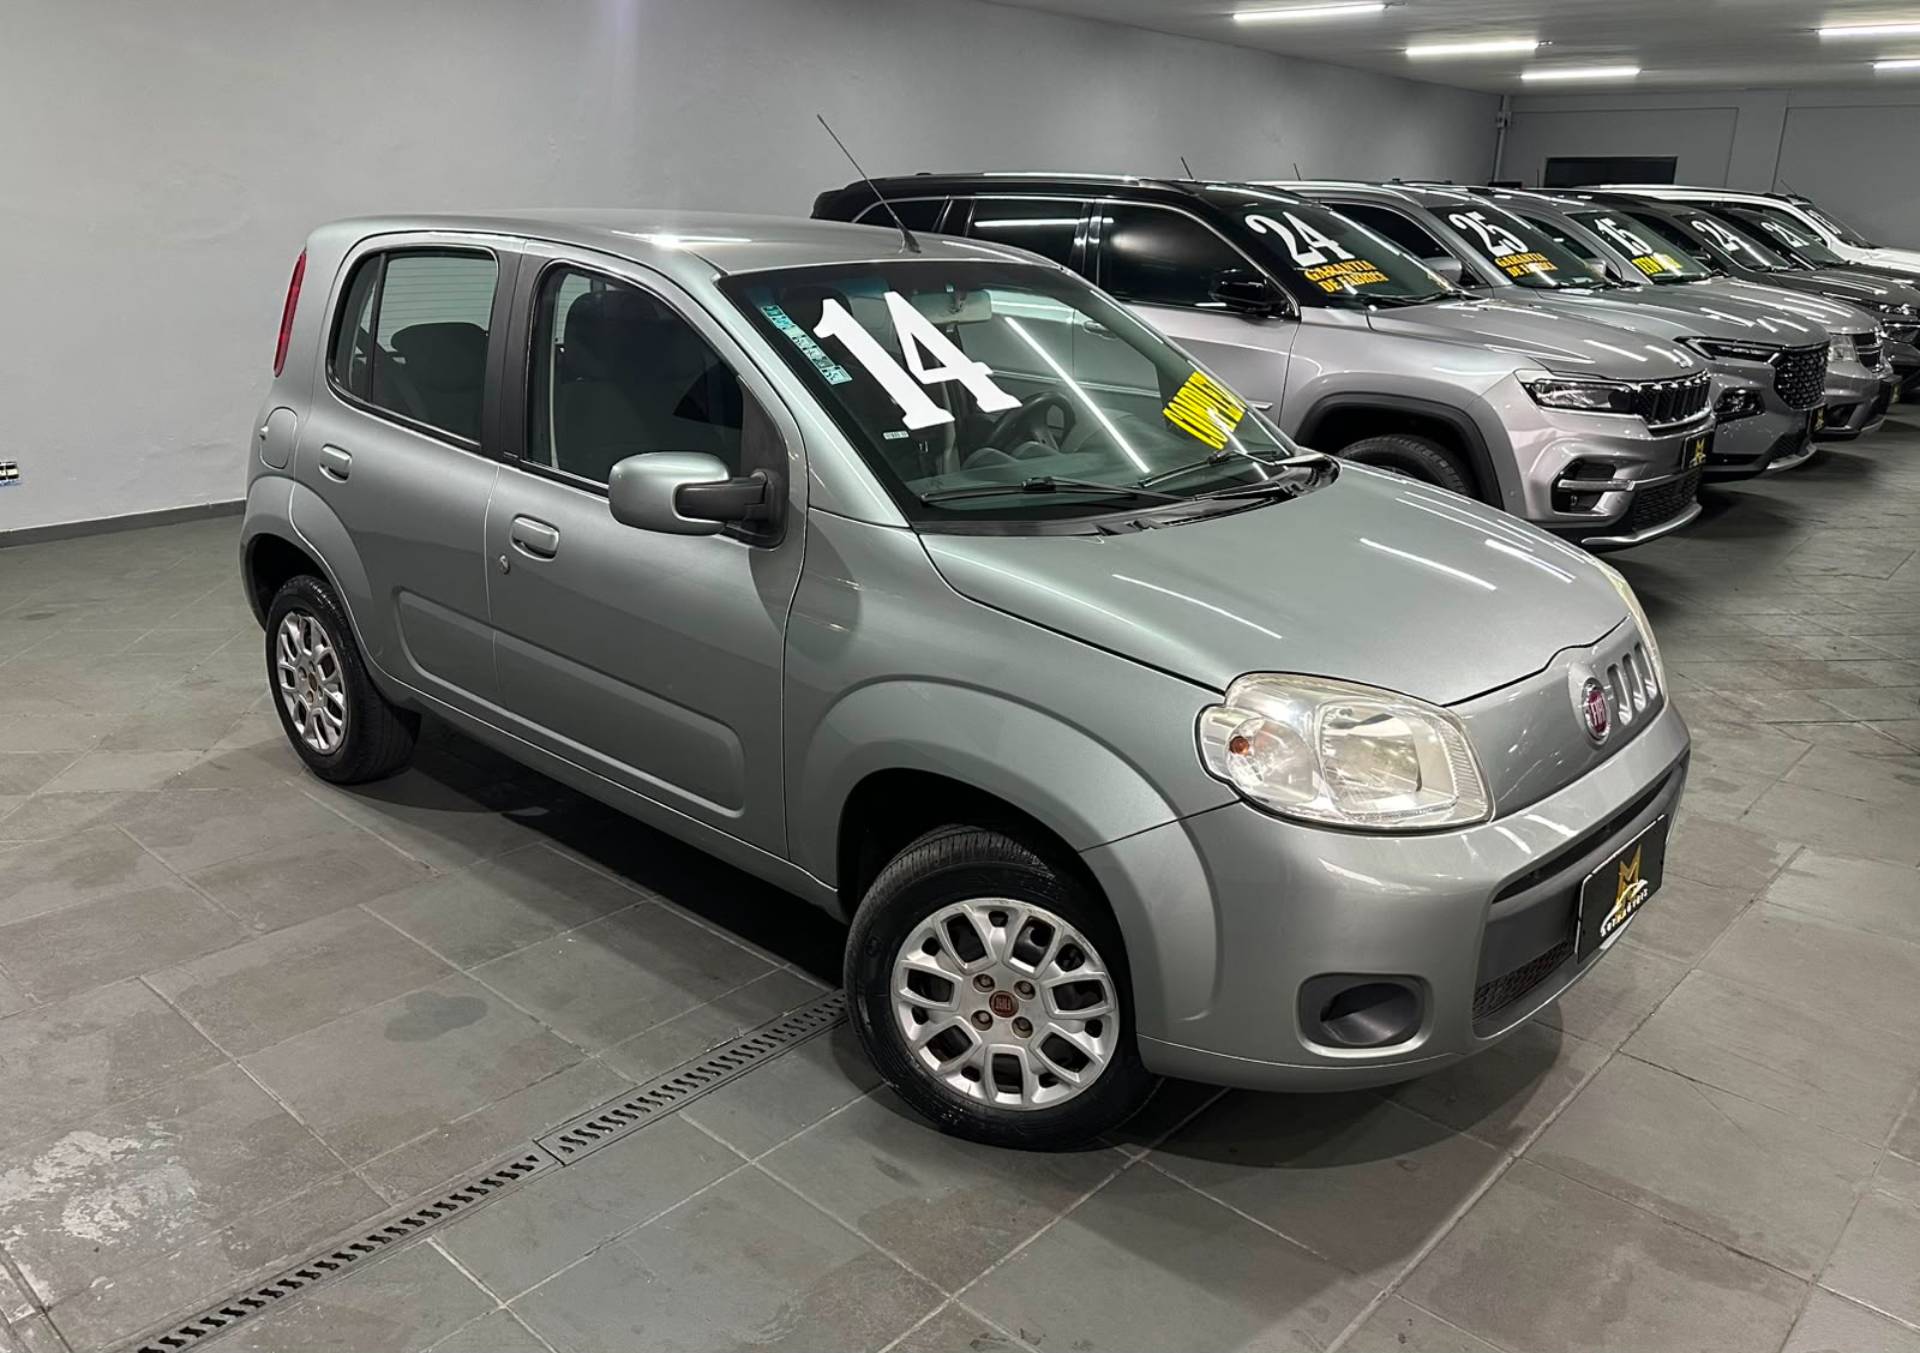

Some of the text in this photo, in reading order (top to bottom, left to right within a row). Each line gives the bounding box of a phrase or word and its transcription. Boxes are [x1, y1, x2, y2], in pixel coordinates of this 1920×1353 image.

[1244, 211, 1355, 267] 24
[1448, 211, 1528, 257] 25
[1594, 218, 1653, 256] 15
[1304, 259, 1377, 281] GARANTIA
[1318, 278, 1343, 292] DE
[813, 291, 1022, 430] 14
